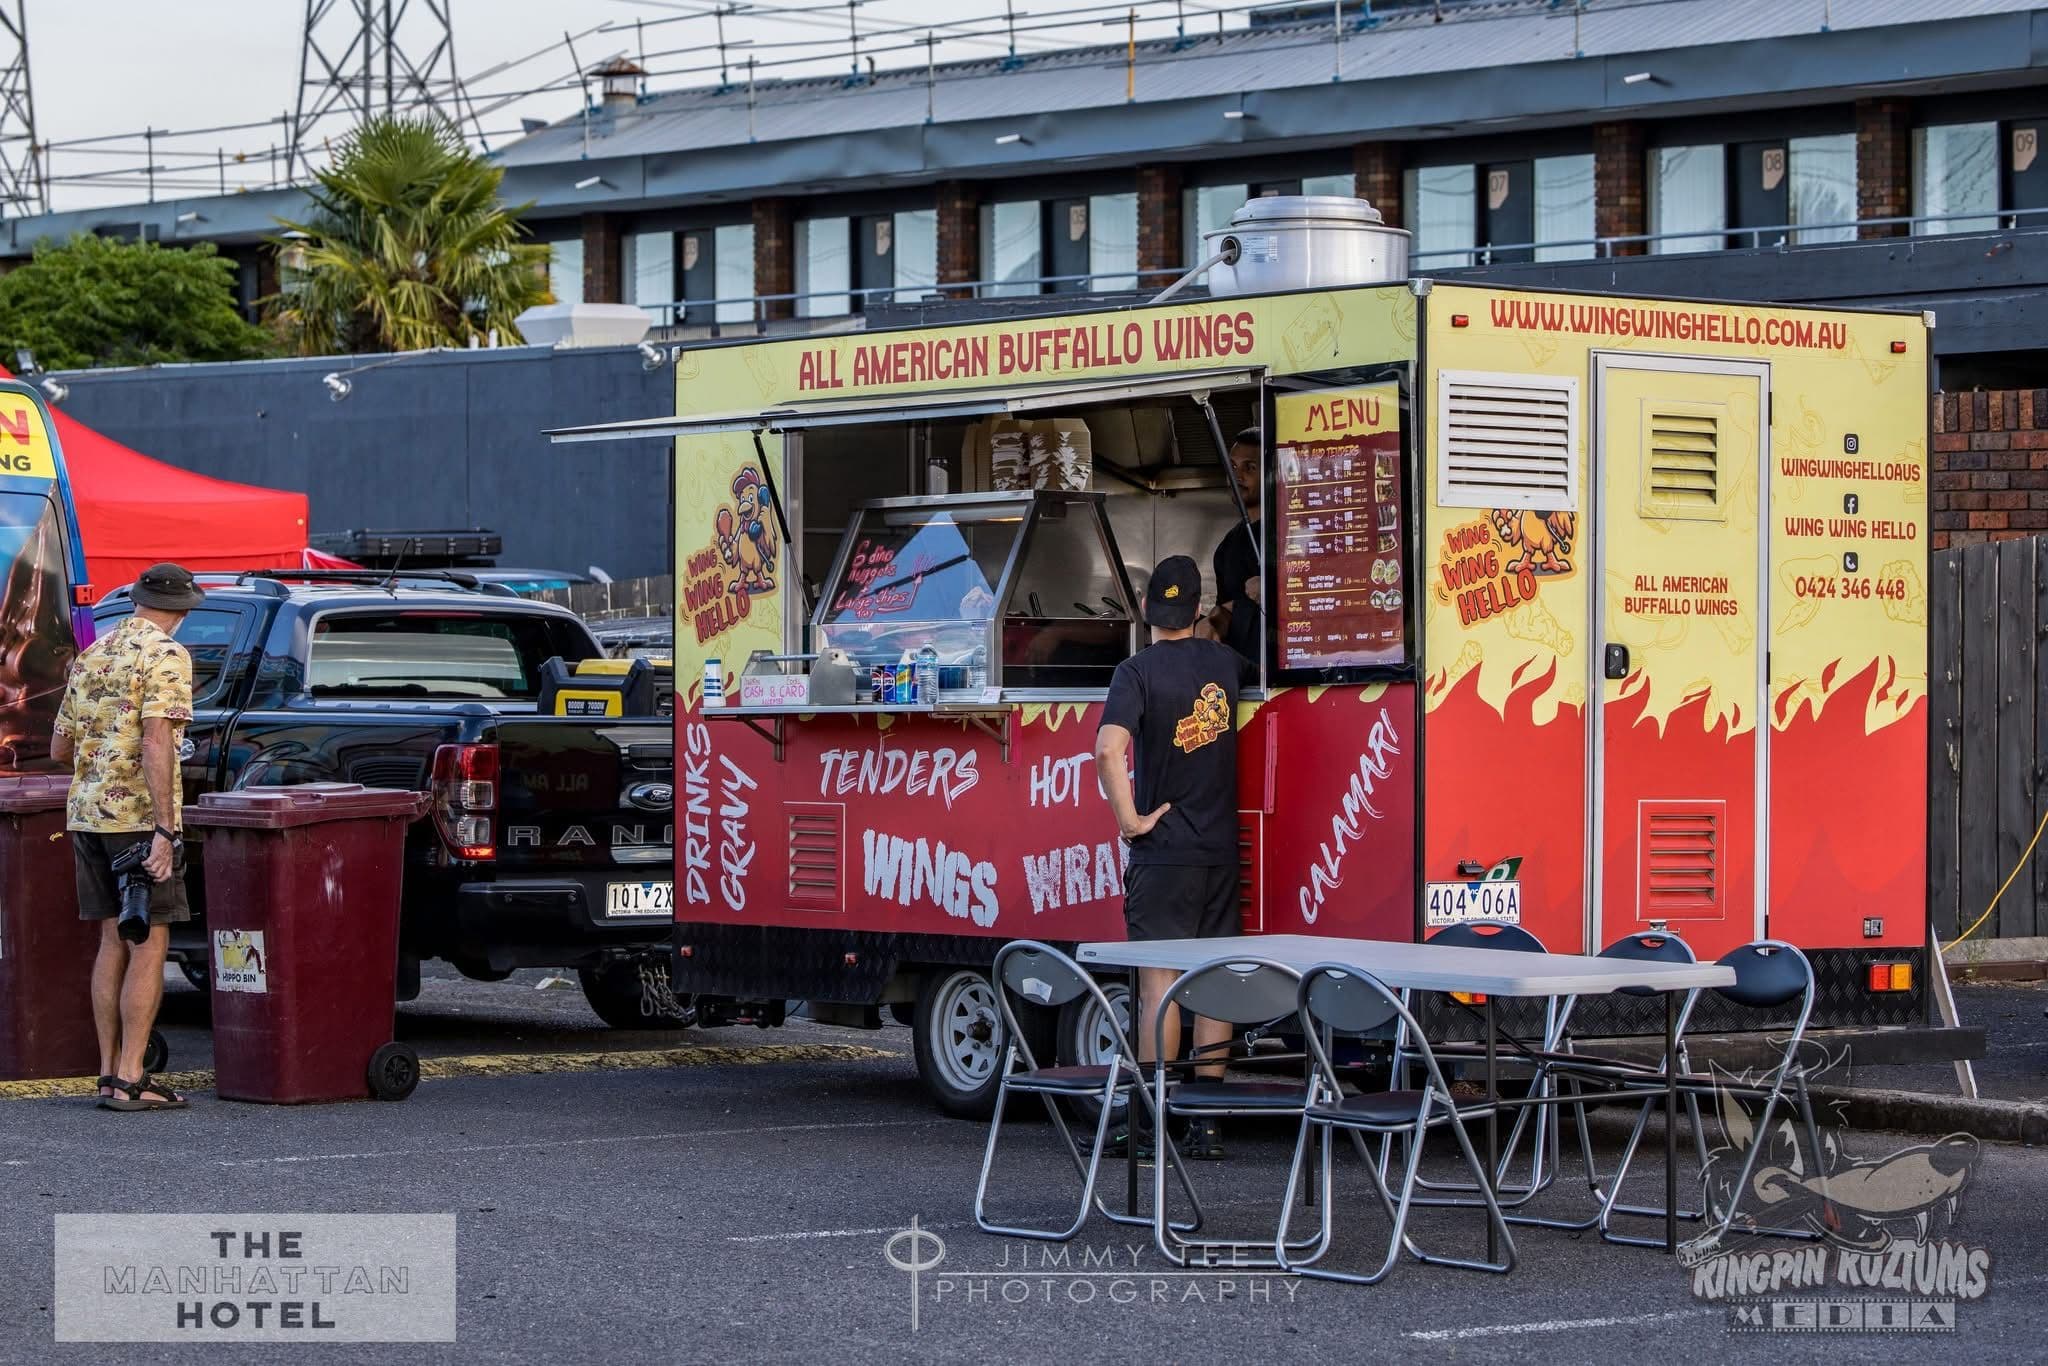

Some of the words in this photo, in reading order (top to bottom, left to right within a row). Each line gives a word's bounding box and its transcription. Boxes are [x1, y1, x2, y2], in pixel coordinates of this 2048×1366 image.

[2016, 134, 2033, 152] 09
[1765, 153, 1781, 170] 08
[1491, 175, 1506, 192] 07
[1491, 299, 1846, 350] WWW.WINGWINGHELLO.COM.AU
[799, 349, 843, 391] ALL
[853, 335, 989, 387] AMERICAN
[999, 321, 1143, 374] BUFFALLO
[1153, 311, 1255, 362] WINGS
[1304, 396, 1380, 433] MENU
[1326, 444, 1361, 459] TENDERS
[1781, 457, 1921, 482] WINGWINGHELLOAUS
[1447, 523, 1490, 554] WING
[1785, 517, 1824, 537] WING
[1829, 519, 1867, 538] WING
[1871, 520, 1917, 540] HELLO
[688, 548, 717, 578] WING
[869, 545, 895, 564] dino
[1286, 560, 1311, 573] WRAPS
[1441, 550, 1500, 591] WING
[1634, 575, 1658, 591] ALL
[1662, 576, 1728, 593] AMERICAN
[684, 573, 723, 612] WING
[1457, 568, 1537, 625] HELLO
[1795, 576, 1836, 598] 0424
[1841, 577, 1871, 600] 346
[1875, 579, 1905, 600] 448
[695, 587, 751, 643] HELLO
[1624, 597, 1691, 614] BUFFALLO
[1695, 599, 1738, 615] WINGS
[1287, 621, 1312, 633] SIDES
[744, 686, 764, 698] CASH
[779, 684, 805, 698] CARD
[820, 747, 980, 811] TENDERS
[1030, 752, 1095, 808] HOT
[684, 722, 712, 905] DRINKS
[1300, 708, 1401, 925] CALAMARI
[719, 753, 759, 912] GRAVY
[863, 828, 999, 928] WINGS
[613, 887, 639, 909] 1QI
[1430, 889, 1466, 916] 404
[1482, 887, 1517, 914] 06A
[243, 974, 256, 983] BIN
